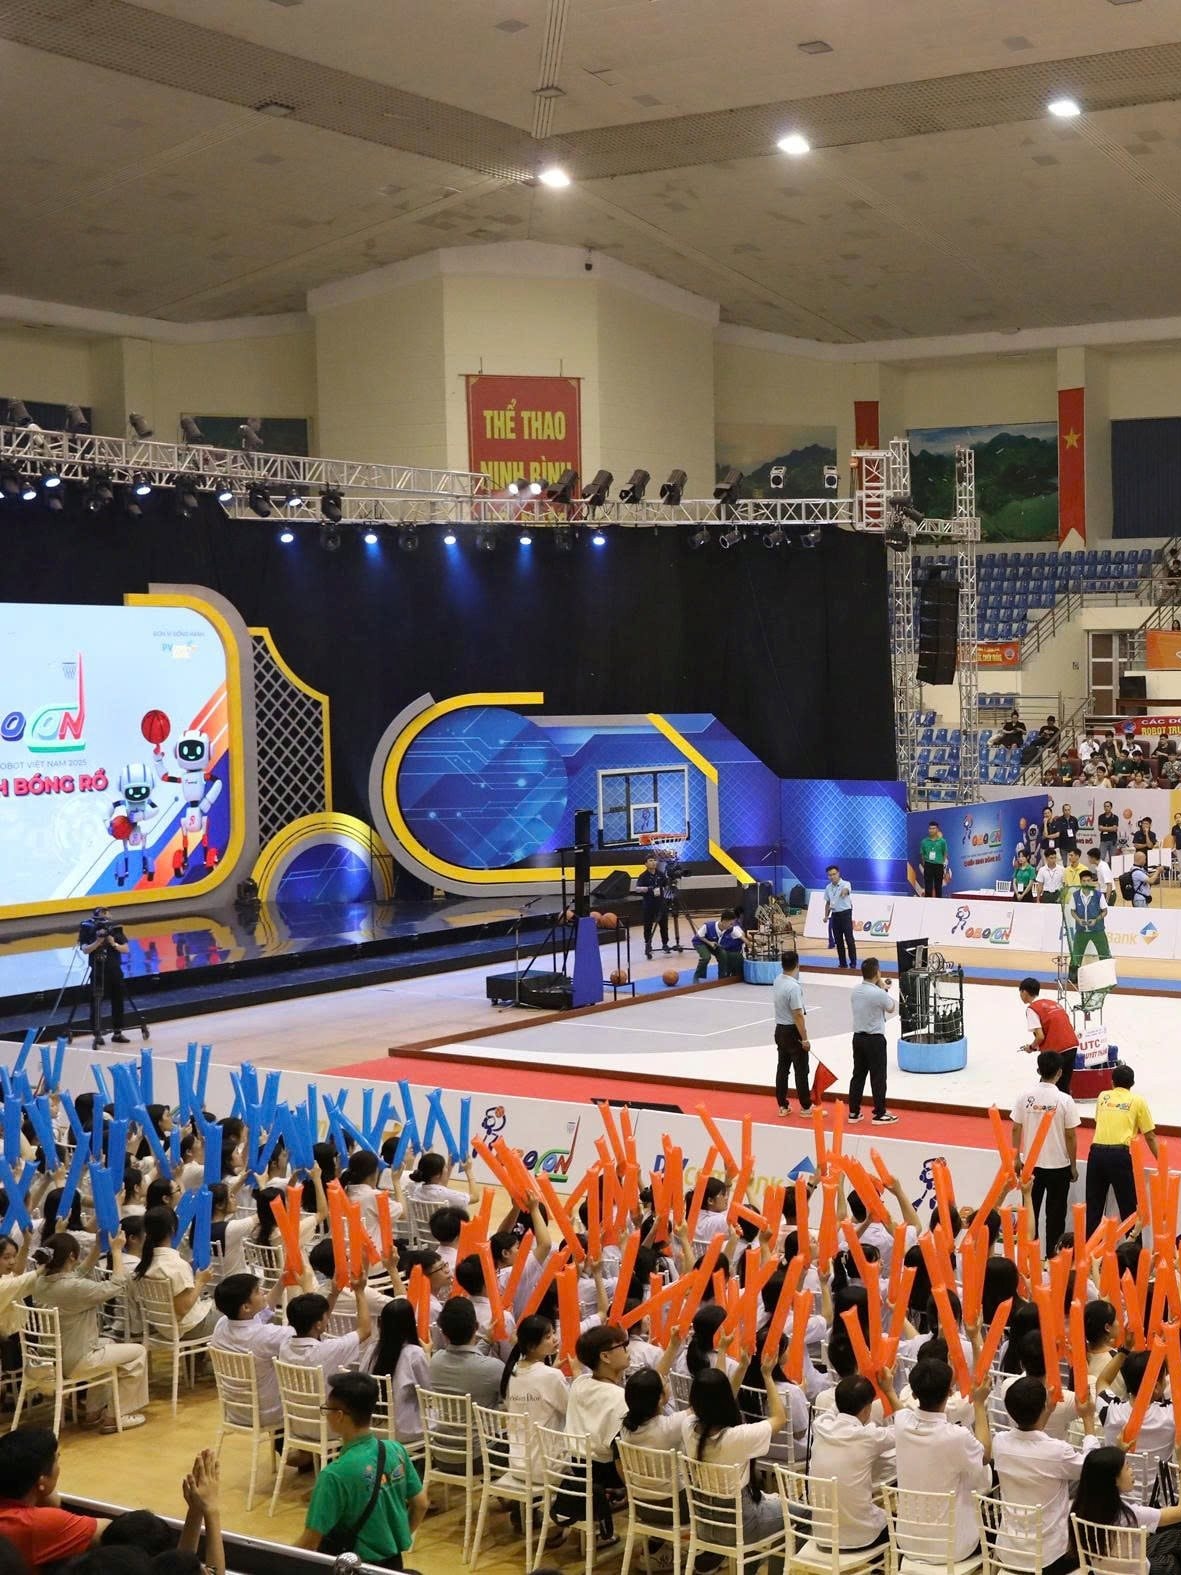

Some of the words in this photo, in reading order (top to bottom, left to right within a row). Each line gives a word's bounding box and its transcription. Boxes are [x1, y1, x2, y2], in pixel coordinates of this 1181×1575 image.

[483, 398, 516, 440] THỂ
[521, 410, 566, 440] THAO
[47, 760, 67, 769] NAM
[13, 772, 75, 796] BÓNG
[1080, 1039, 1100, 1051] UTC
